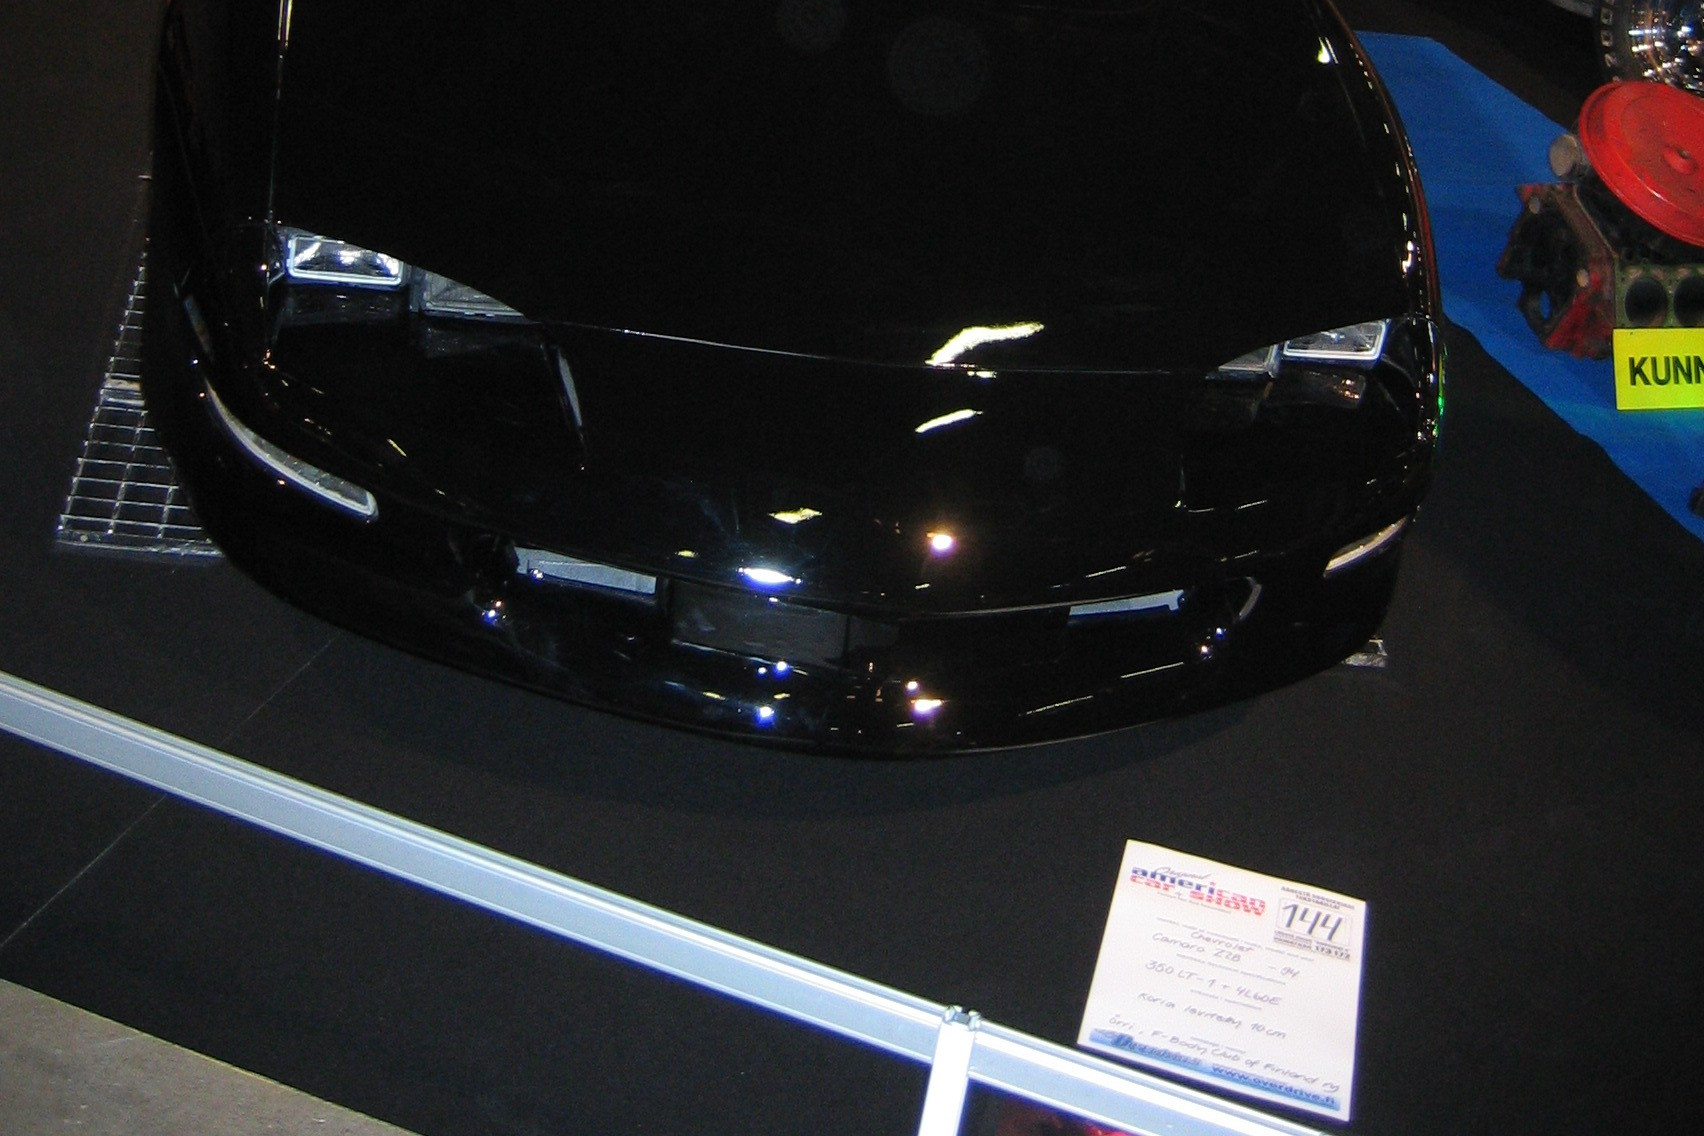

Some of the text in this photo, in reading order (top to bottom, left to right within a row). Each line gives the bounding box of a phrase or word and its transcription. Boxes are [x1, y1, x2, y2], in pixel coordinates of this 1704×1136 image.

[1130, 874, 1175, 892] car
[1189, 889, 1266, 917] show
[1131, 866, 1266, 910] american
[1282, 904, 1343, 942] 144
[1152, 931, 1205, 953] Camaro
[1190, 930, 1254, 953] Chevrolet
[1145, 960, 1175, 975] 350
[1244, 1058, 1260, 1068] of
[1263, 1063, 1320, 1084] Finland
